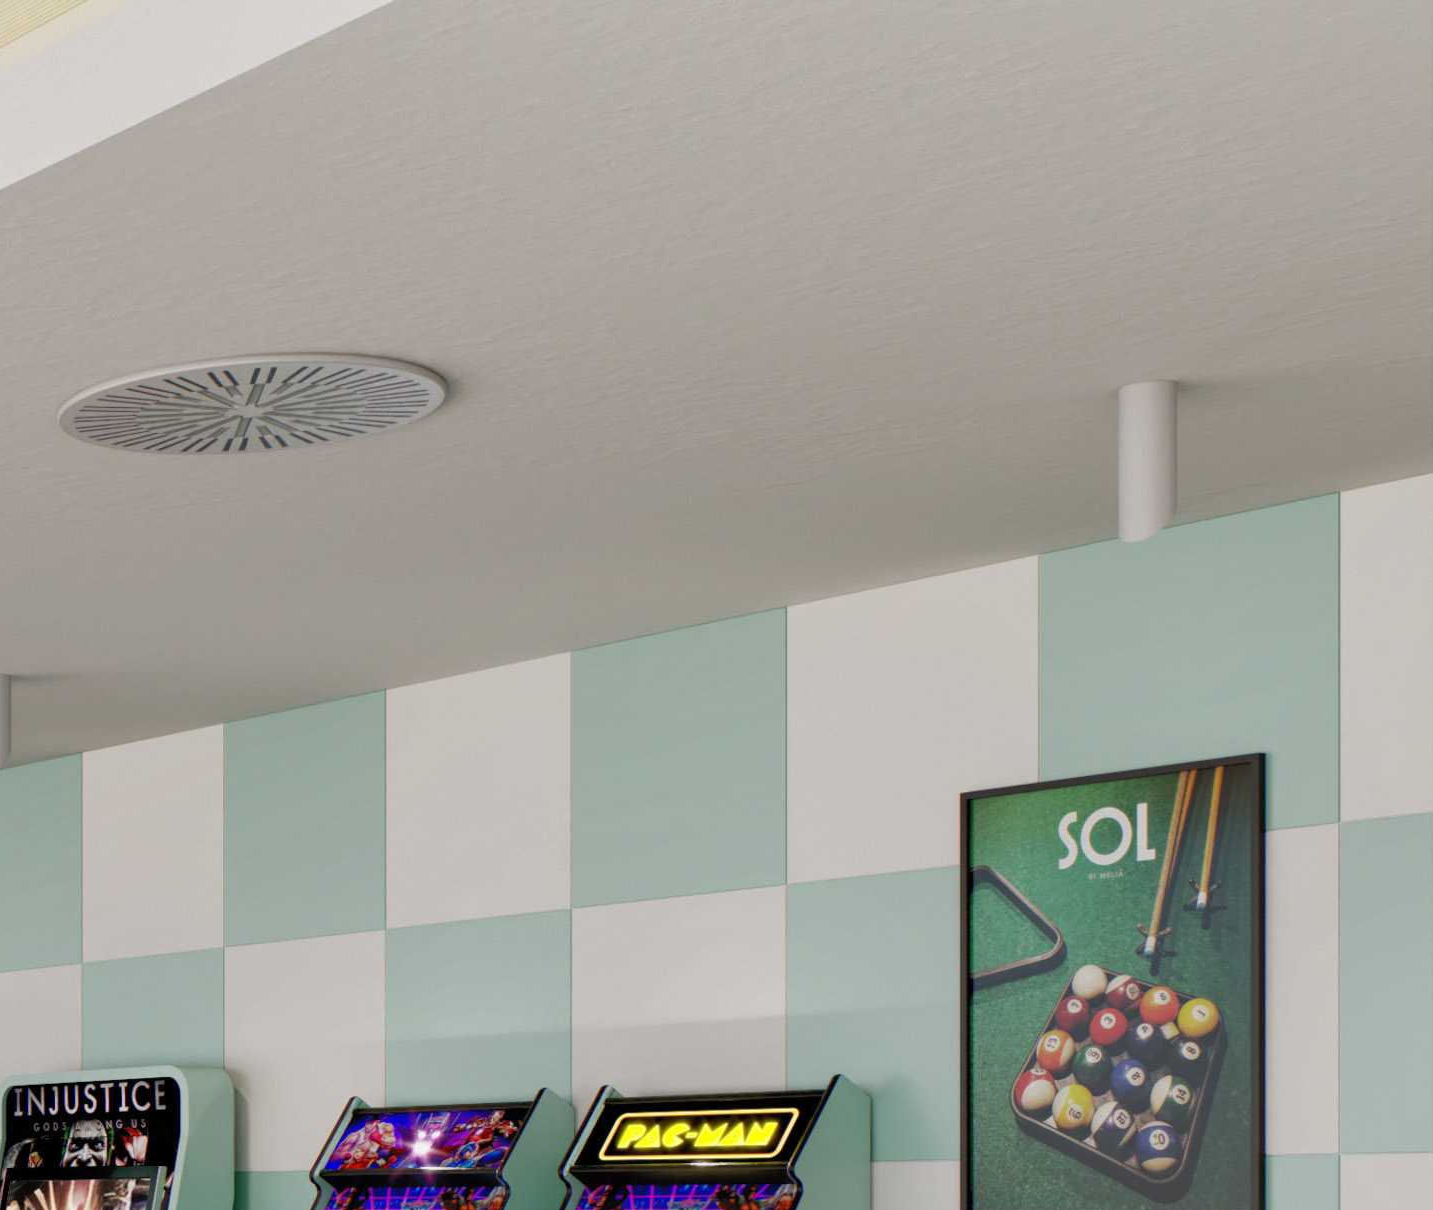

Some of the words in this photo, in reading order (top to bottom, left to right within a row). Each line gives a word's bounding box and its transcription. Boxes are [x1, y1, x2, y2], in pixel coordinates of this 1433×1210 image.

[1057, 802, 1156, 870] SOL
[1046, 1037, 1059, 1049] 13
[14, 1080, 167, 1117] INJUSTICE
[1176, 1087, 1187, 1101] 14
[33, 1121, 67, 1132] GODS
[75, 1119, 123, 1132] AMONG
[131, 1118, 147, 1129] US
[616, 1121, 779, 1149] PAC-MAN
